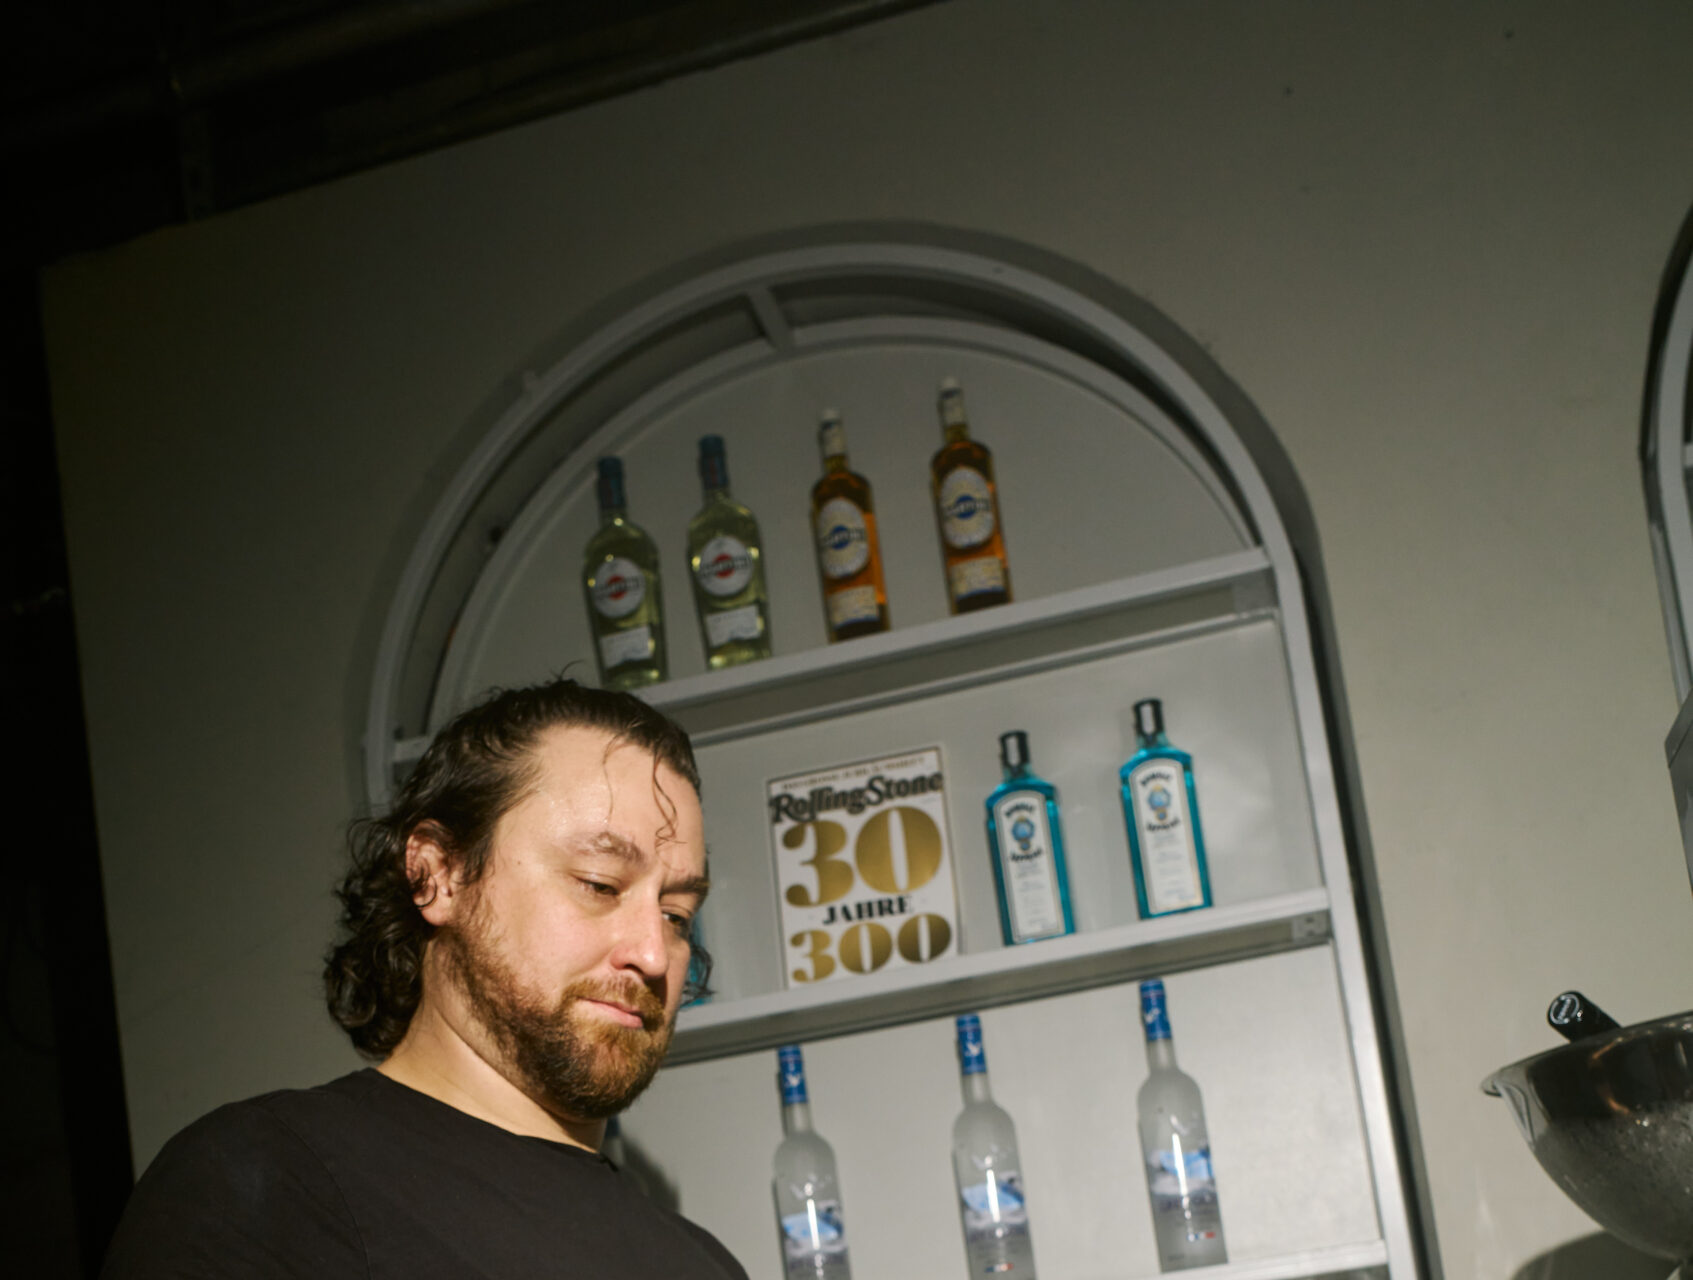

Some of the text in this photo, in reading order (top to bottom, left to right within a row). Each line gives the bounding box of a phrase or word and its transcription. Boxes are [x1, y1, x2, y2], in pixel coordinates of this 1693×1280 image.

[782, 805, 943, 908] 30
[822, 895, 914, 925] JAHRE
[790, 913, 952, 983] 300
